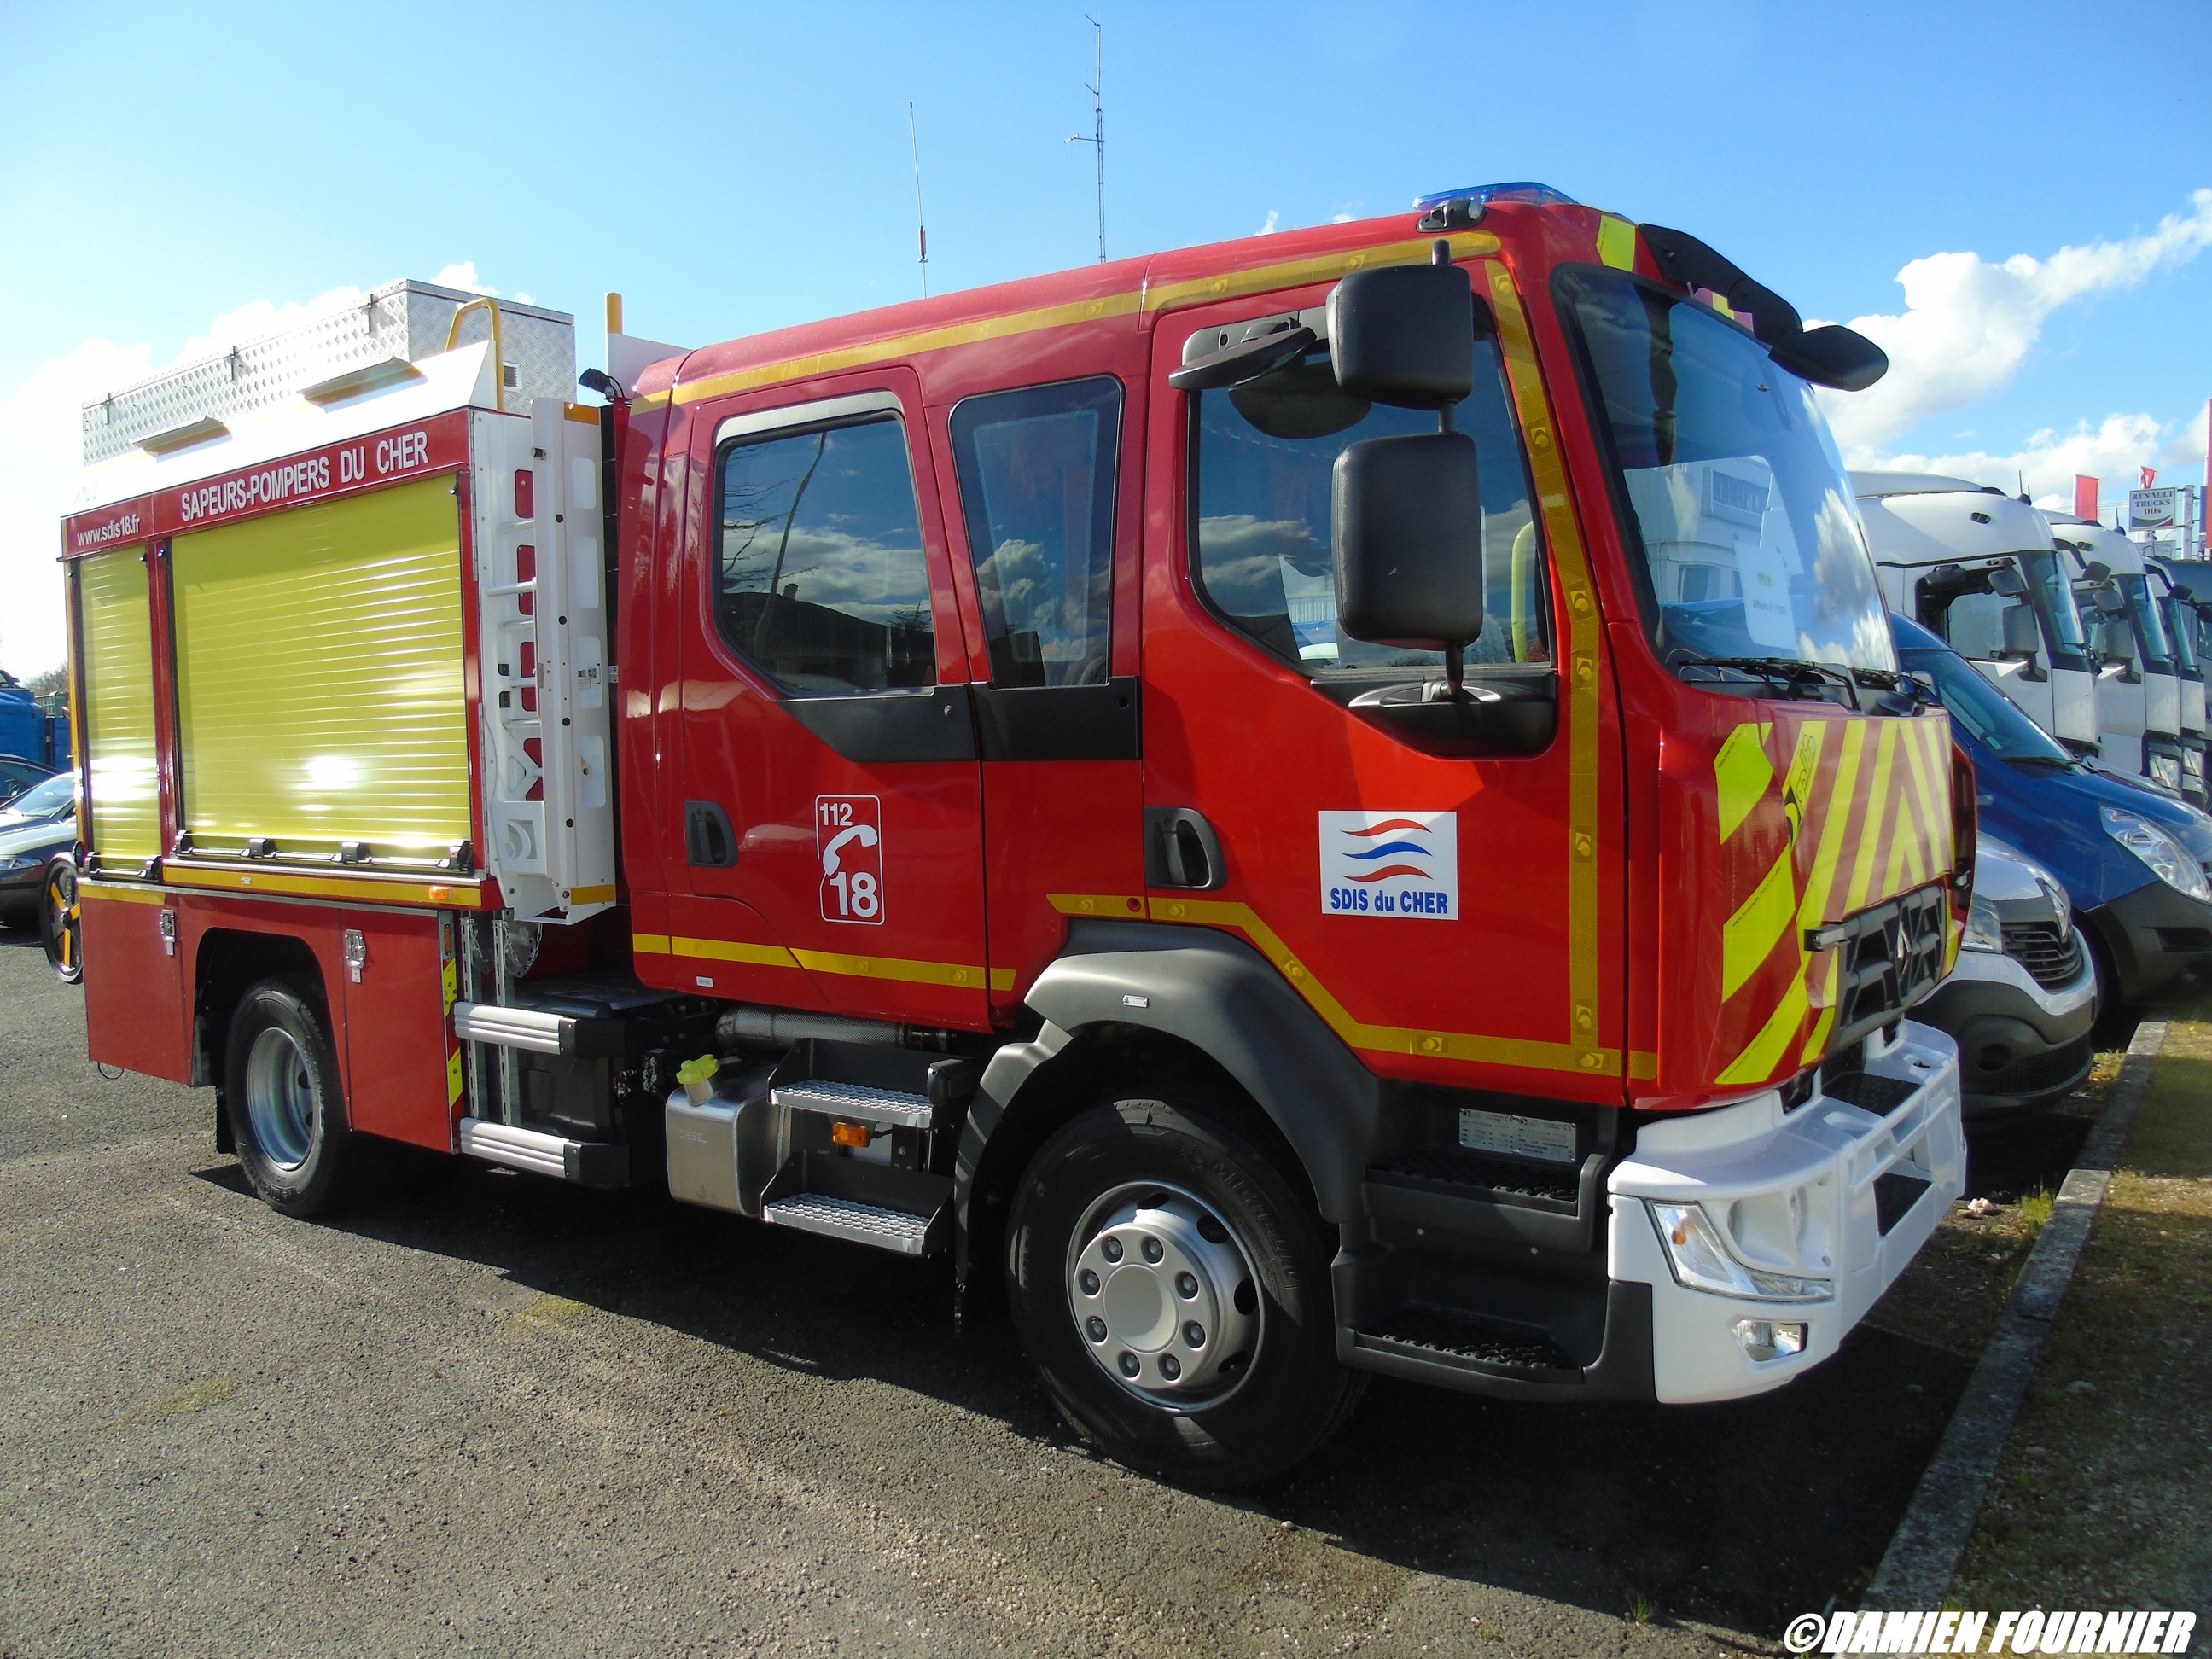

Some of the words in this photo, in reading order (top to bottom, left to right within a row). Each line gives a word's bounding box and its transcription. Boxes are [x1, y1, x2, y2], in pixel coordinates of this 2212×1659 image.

[181, 455, 330, 521] SAPEURS-POMPIERS
[341, 446, 366, 484] DU
[376, 431, 429, 474] CHER
[2132, 491, 2172, 499] RENAULT
[77, 514, 141, 546] www.sdis18.fr
[820, 803, 853, 826] 112
[830, 871, 879, 917] 18
[1330, 888, 1369, 911] SDIS
[1374, 890, 1394, 911] du
[1400, 890, 1448, 914] CHER
